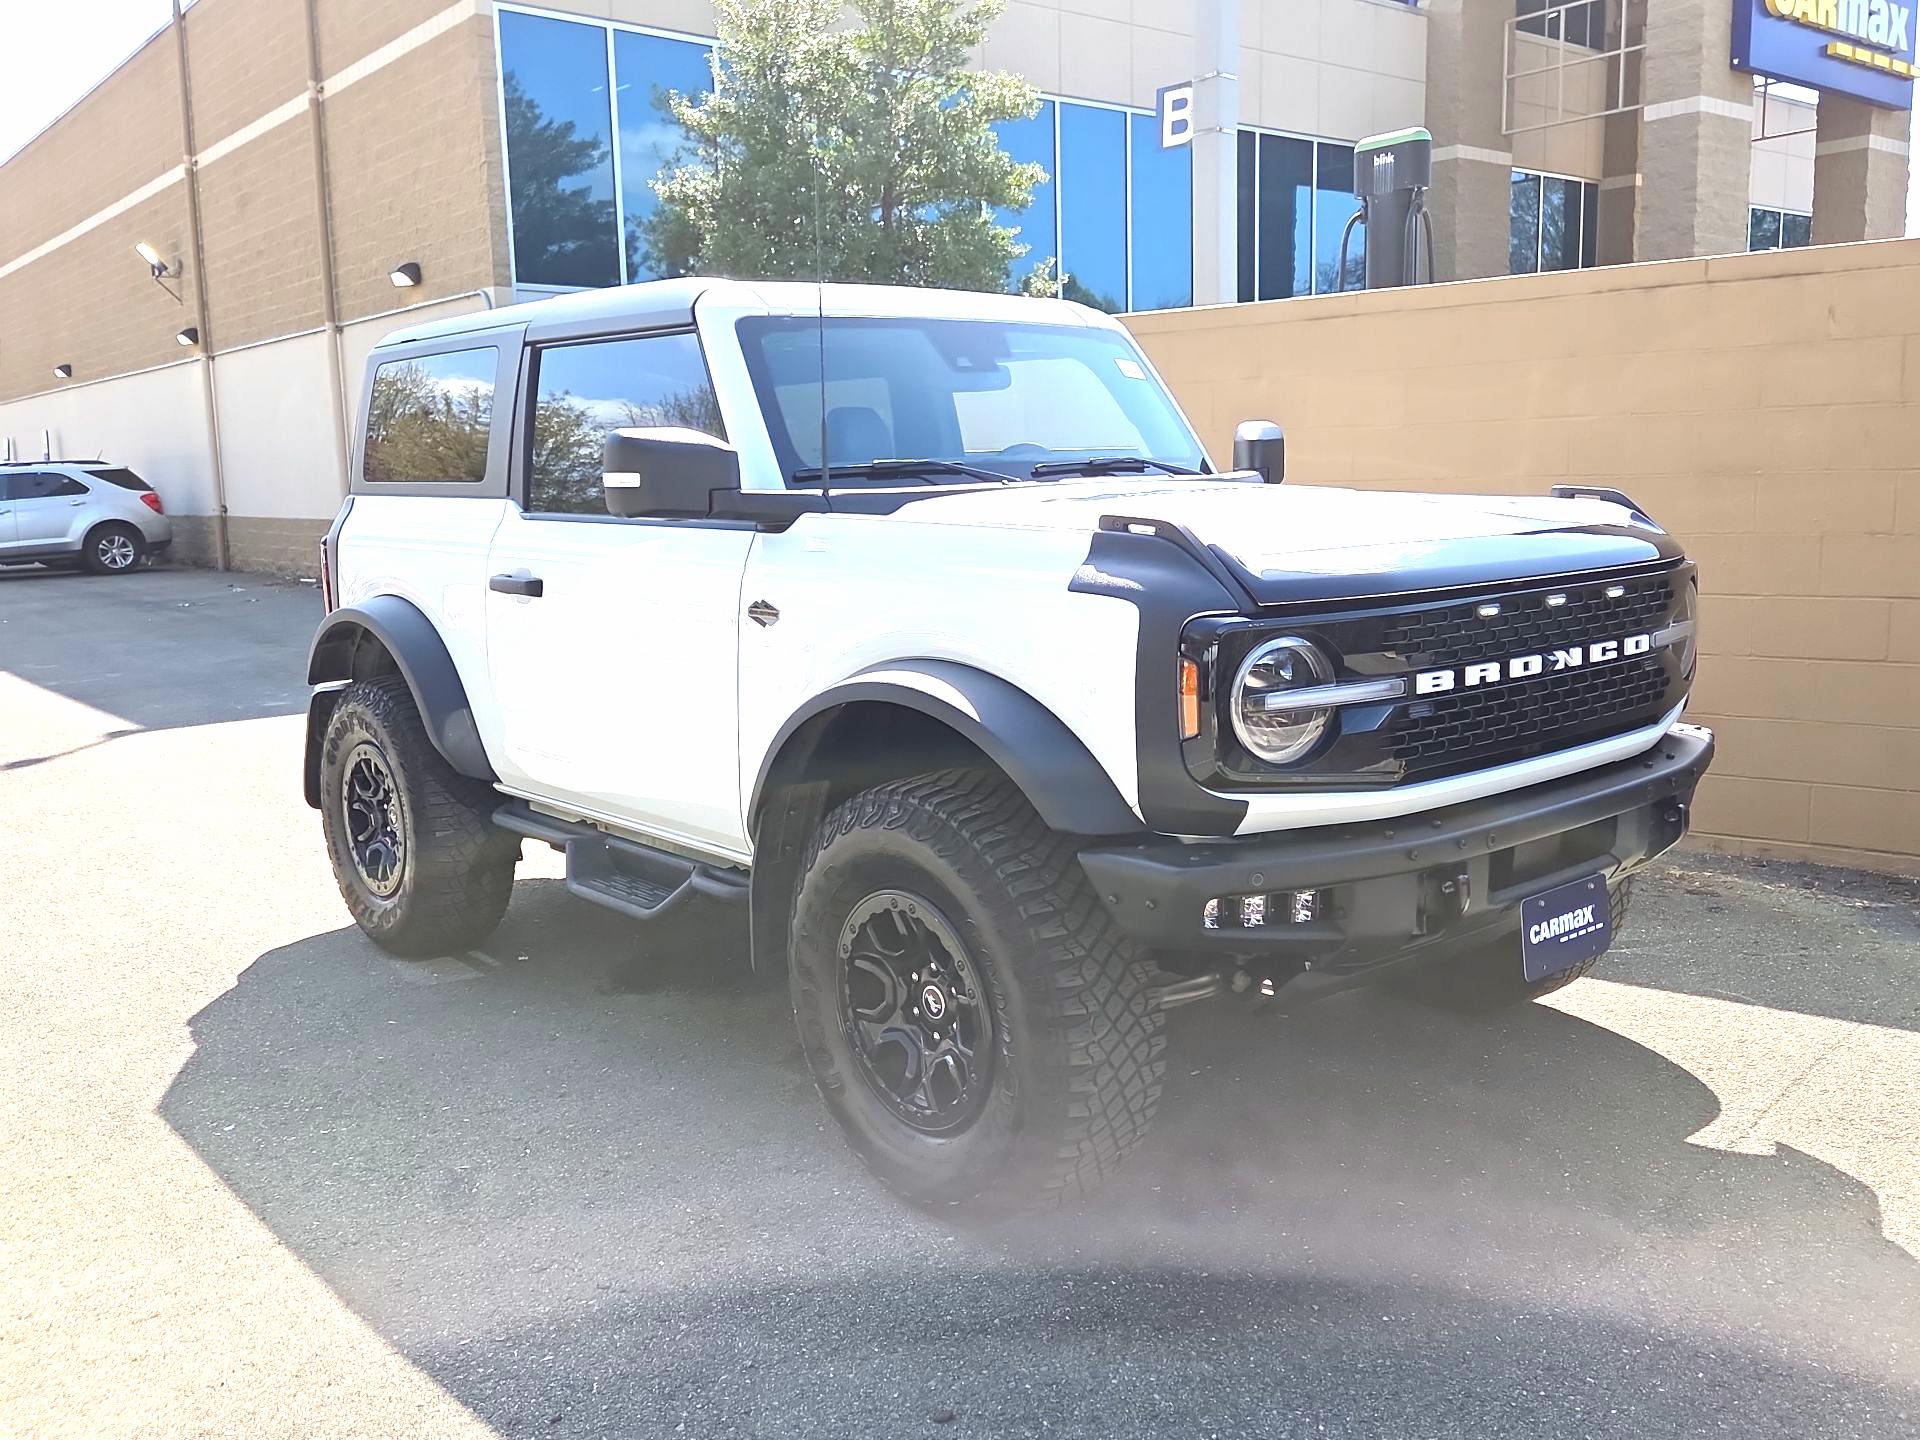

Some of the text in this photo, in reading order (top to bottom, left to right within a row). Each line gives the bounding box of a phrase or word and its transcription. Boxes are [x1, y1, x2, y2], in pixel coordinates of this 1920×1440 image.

[1162, 87, 1193, 149] B
[1373, 152, 1395, 166] blink
[1415, 633, 1650, 695] BRONCO
[1529, 904, 1595, 945] CARmax
